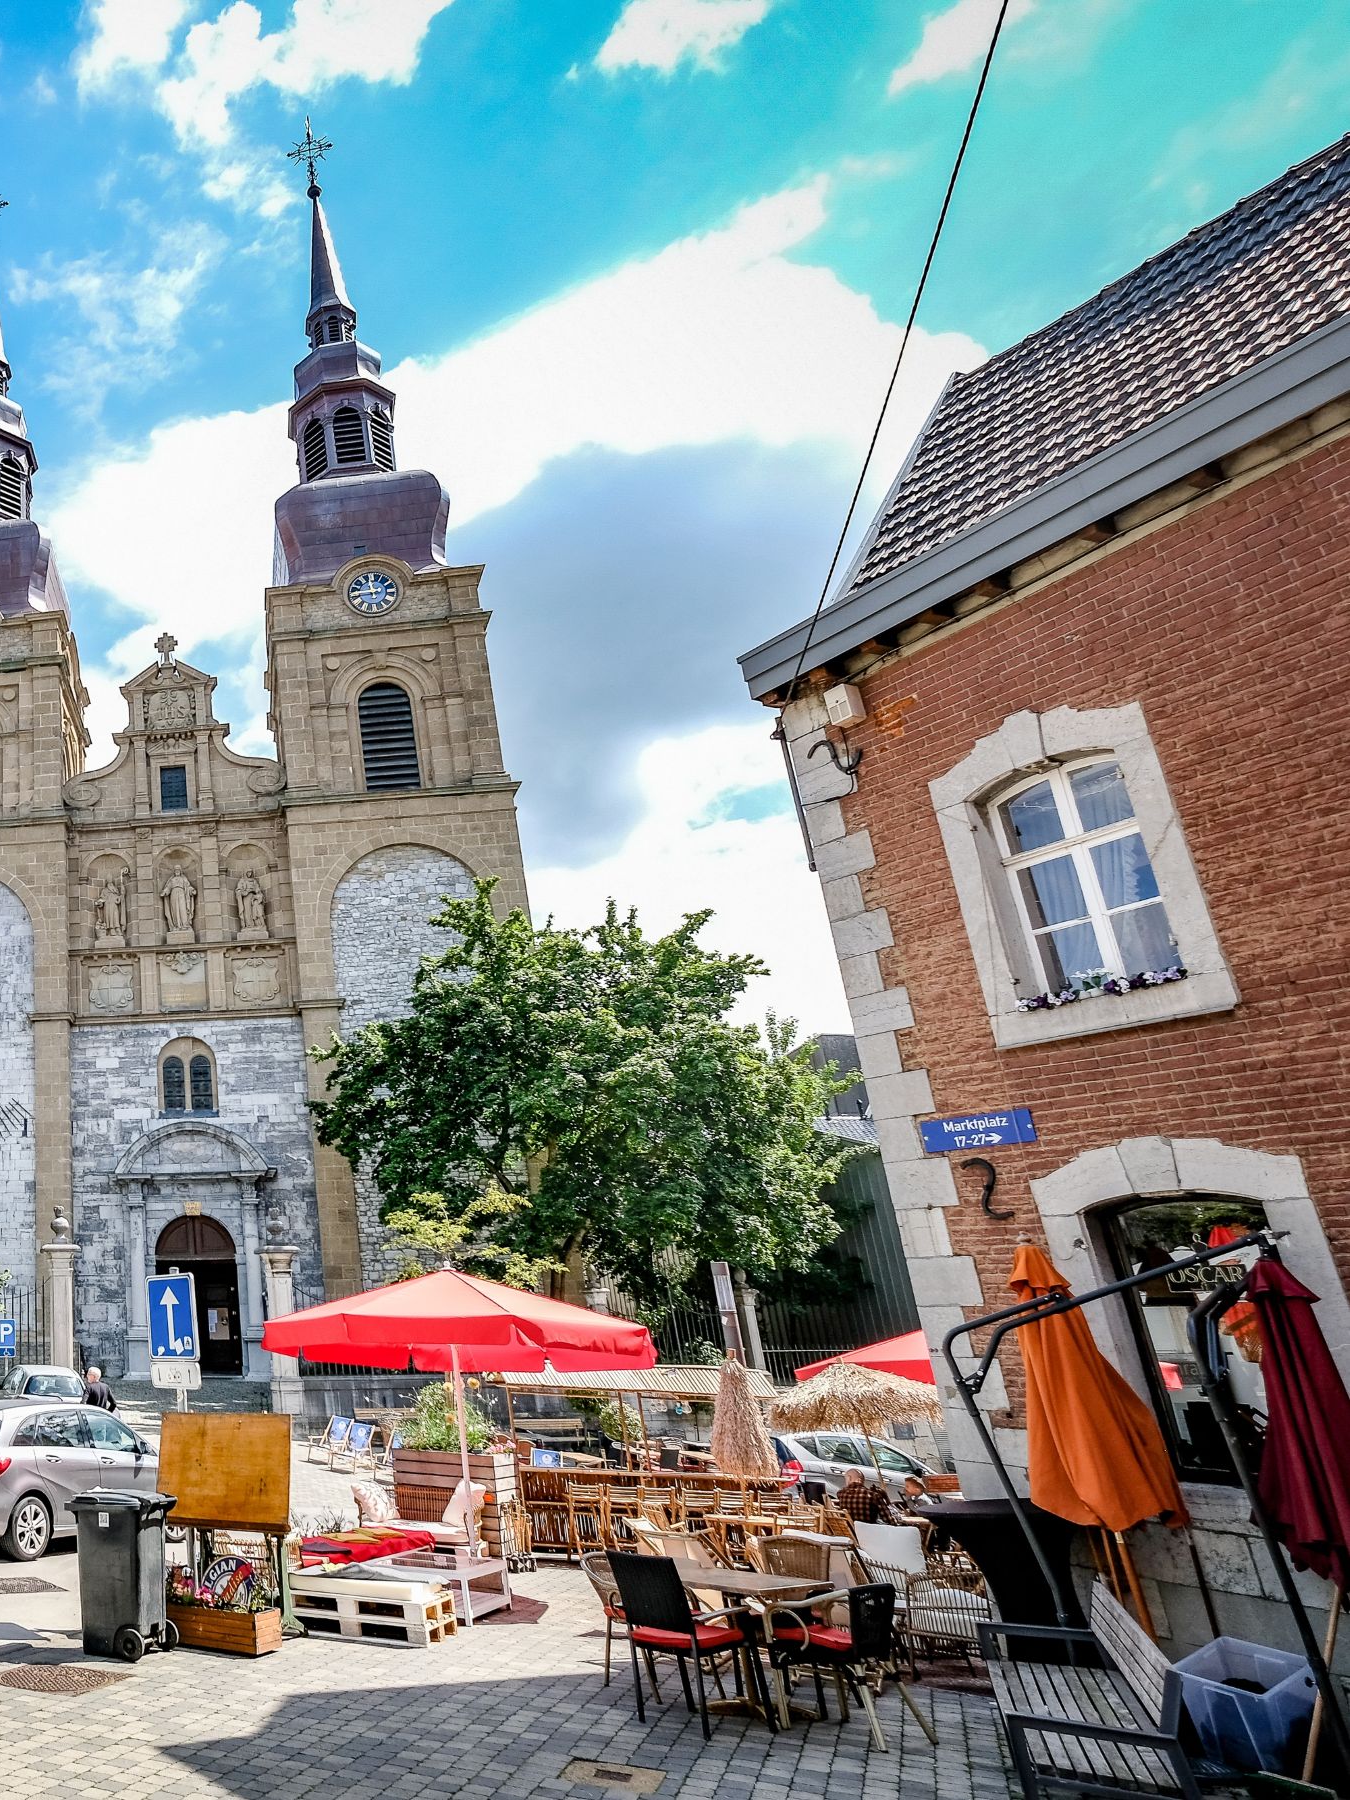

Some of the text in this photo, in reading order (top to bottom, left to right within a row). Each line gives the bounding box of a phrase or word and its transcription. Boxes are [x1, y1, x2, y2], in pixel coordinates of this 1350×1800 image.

[942, 1116, 1009, 1133] Marktplatz
[954, 1133, 987, 1147] 17-27
[1168, 1266, 1244, 1283] OSCAR
[0, 1323, 14, 1343] P
[204, 1559, 237, 1589] LGIAN
